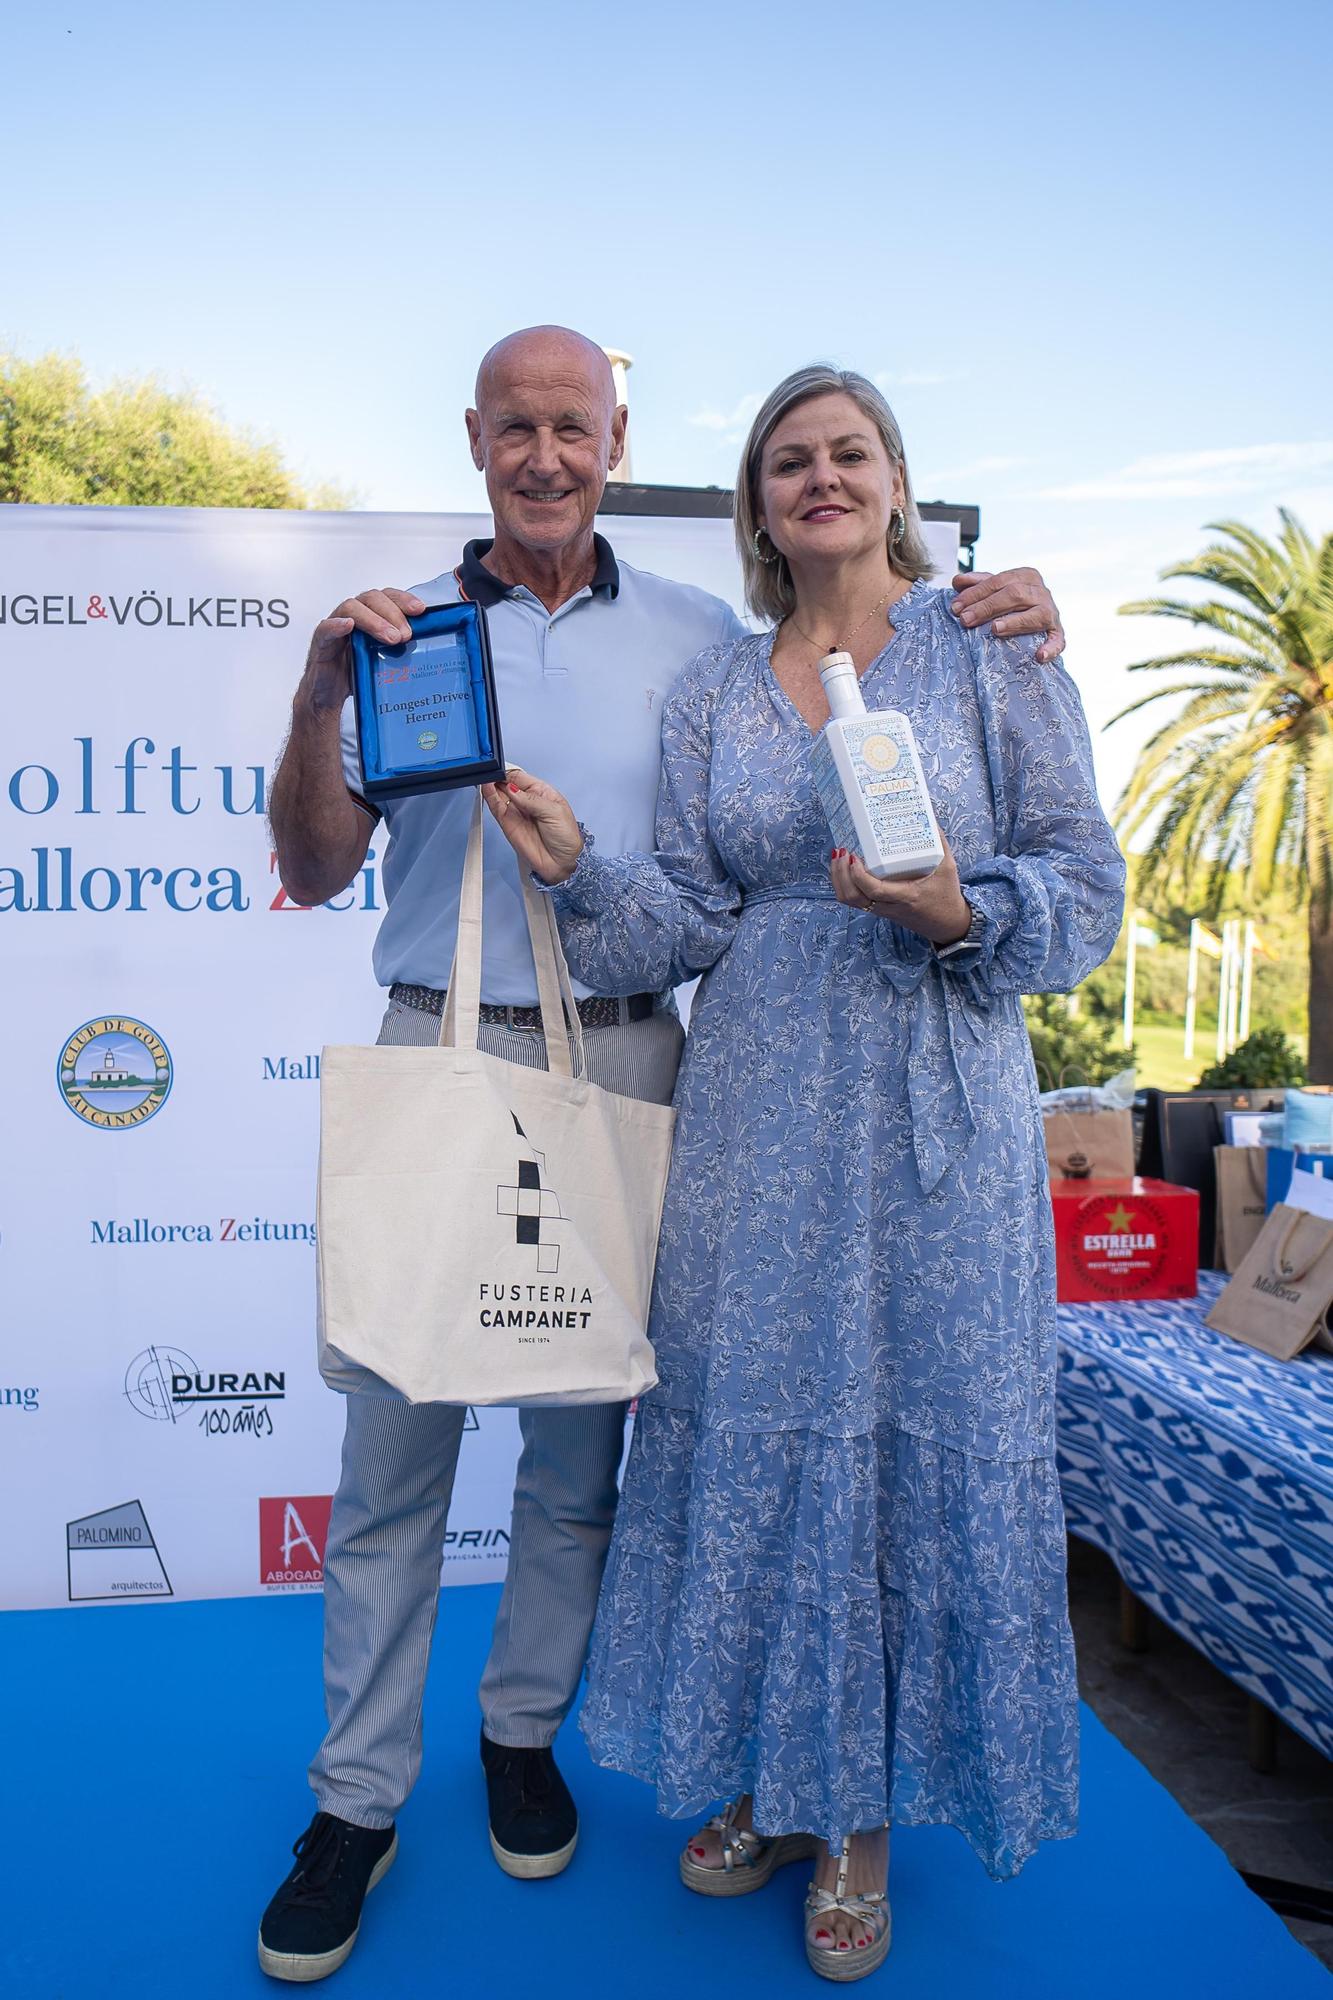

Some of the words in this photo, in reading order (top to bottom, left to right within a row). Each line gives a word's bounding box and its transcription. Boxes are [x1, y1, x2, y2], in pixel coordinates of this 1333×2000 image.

[406, 710, 446, 724] Herren
[869, 780, 911, 794] PALMA
[64, 1026, 97, 1064] CLUB
[104, 1020, 125, 1032] DE
[133, 1026, 166, 1063] GOLF
[69, 1098, 160, 1127] ALCANADA
[90, 1218, 213, 1244] Mallorca
[1083, 1233, 1156, 1251] ESTRELLA
[480, 1283, 592, 1304] FUSTERIA
[480, 1309, 591, 1329] CAMPANET
[171, 1371, 285, 1394] DURAN
[199, 1408, 230, 1437] 100
[77, 1527, 142, 1543] PALOMINO
[111, 1580, 164, 1592] arquitectos
